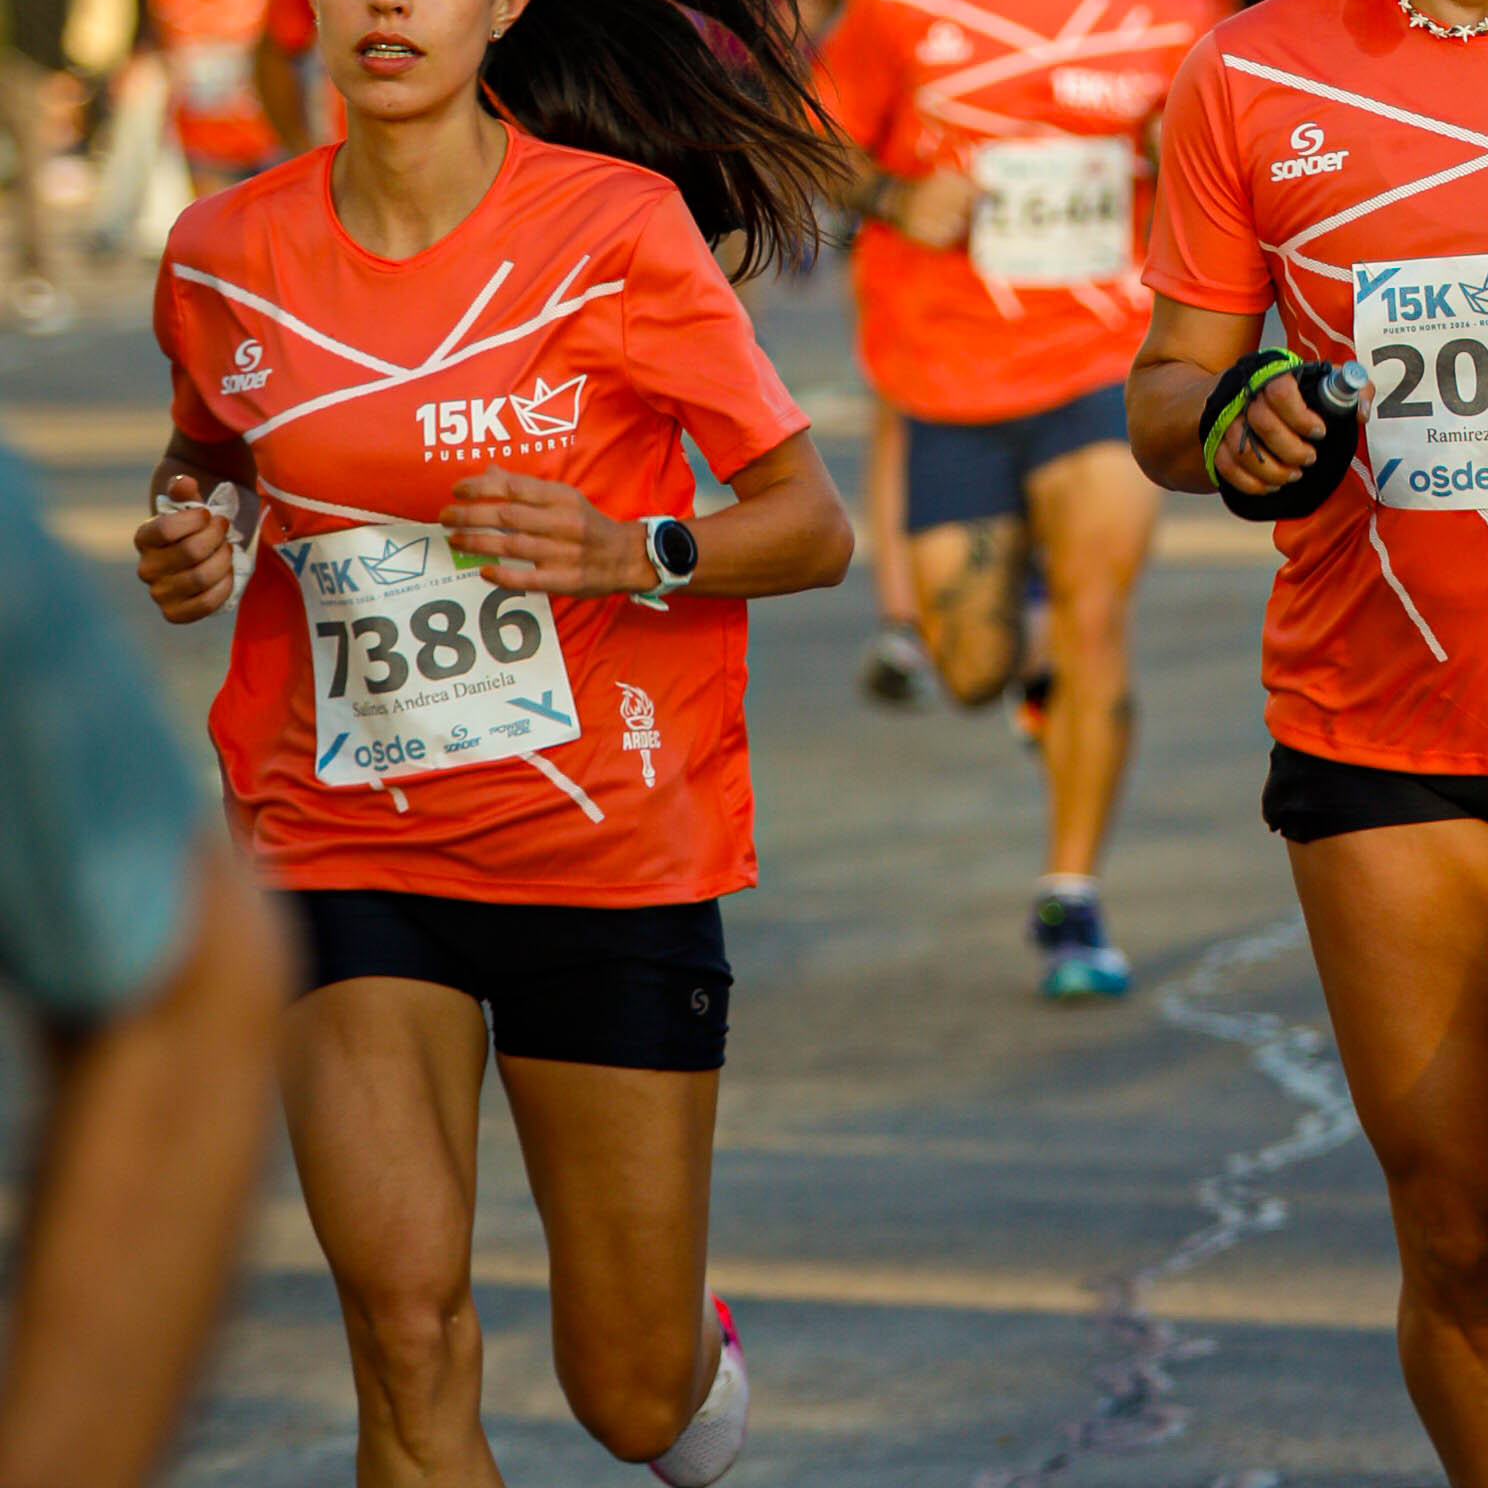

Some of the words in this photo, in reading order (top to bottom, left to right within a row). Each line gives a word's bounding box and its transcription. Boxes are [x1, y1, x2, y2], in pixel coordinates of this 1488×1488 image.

[1381, 283, 1456, 322] 15K
[1383, 325, 1417, 335] PUERTO
[1419, 323, 1447, 331] NORTE
[415, 397, 511, 447] 15K
[424, 446, 512, 463] PUERTO
[310, 558, 360, 596] 15K
[316, 586, 542, 699] 7386
[392, 691, 449, 713] Andrea
[453, 672, 516, 699] Daniela
[354, 736, 426, 771] osde
[622, 730, 661, 751] ARDEC
